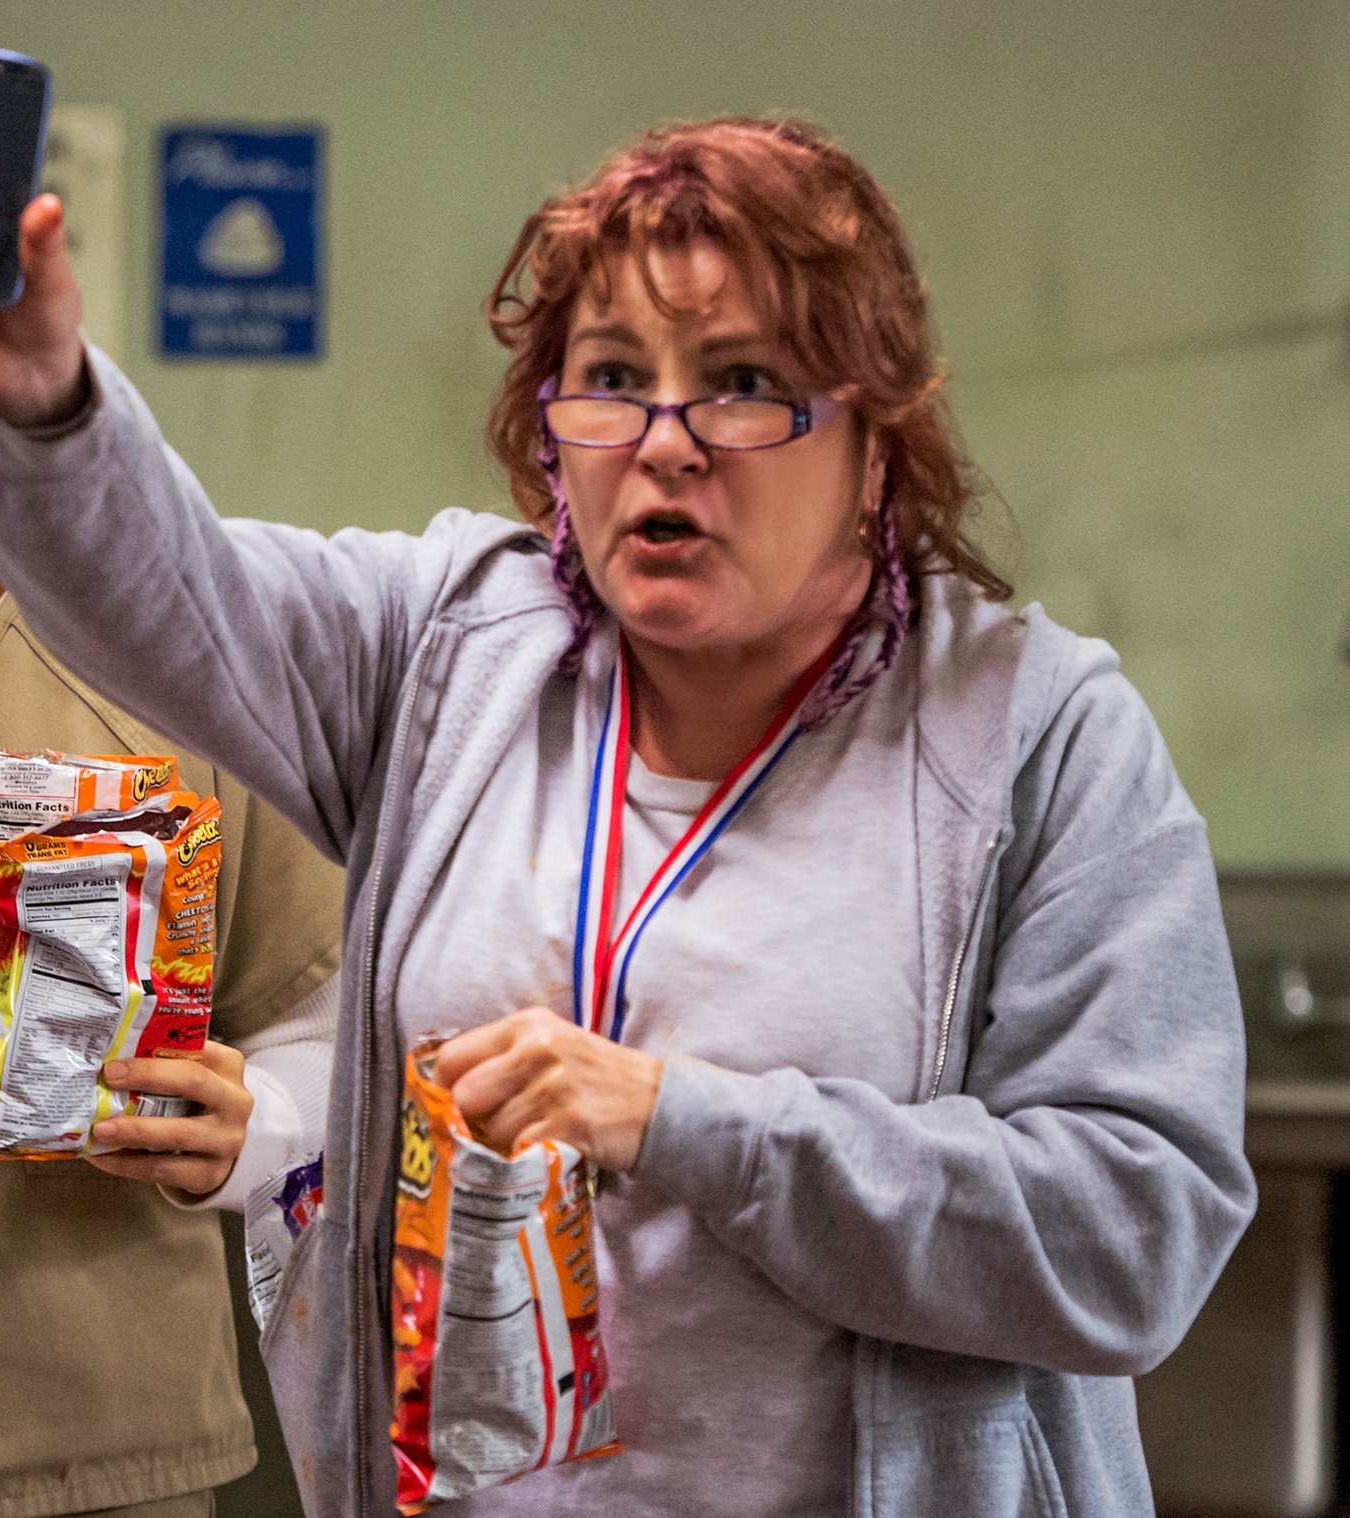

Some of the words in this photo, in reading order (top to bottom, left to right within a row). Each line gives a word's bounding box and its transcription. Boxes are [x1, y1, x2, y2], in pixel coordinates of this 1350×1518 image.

[36, 802, 69, 812] Facts
[26, 842, 34, 852] 0
[36, 842, 66, 850] GRAMS
[27, 850, 52, 859] TRANS
[26, 882, 78, 892] Nutrition
[83, 878, 116, 887] Facts
